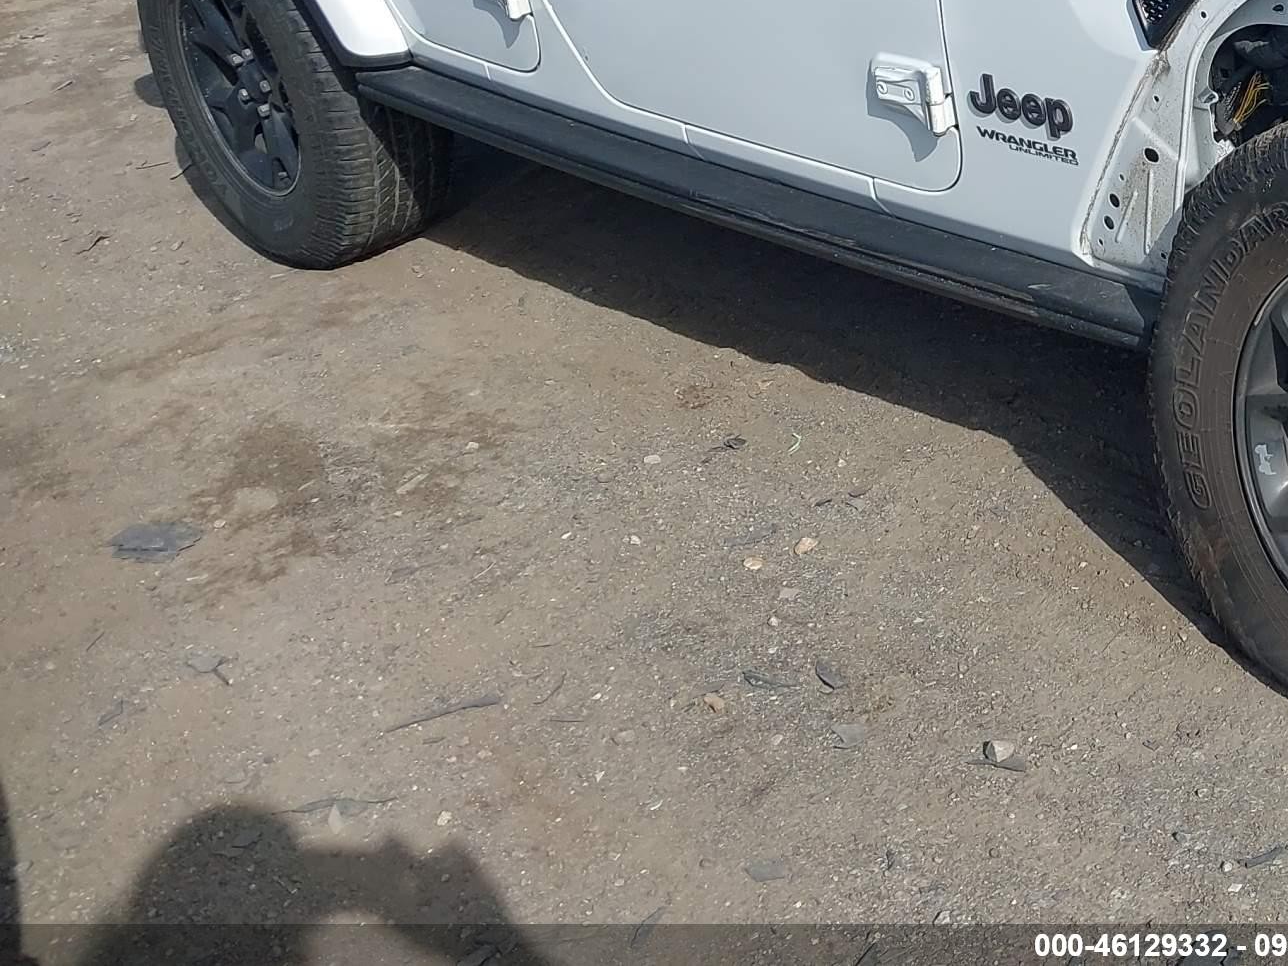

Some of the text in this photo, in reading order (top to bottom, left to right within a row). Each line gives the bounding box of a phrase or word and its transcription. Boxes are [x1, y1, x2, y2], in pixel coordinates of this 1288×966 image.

[966, 73, 1074, 142] Jeep
[976, 125, 1078, 161] WRANGLER
[1008, 144, 1079, 166] UNLIMITED
